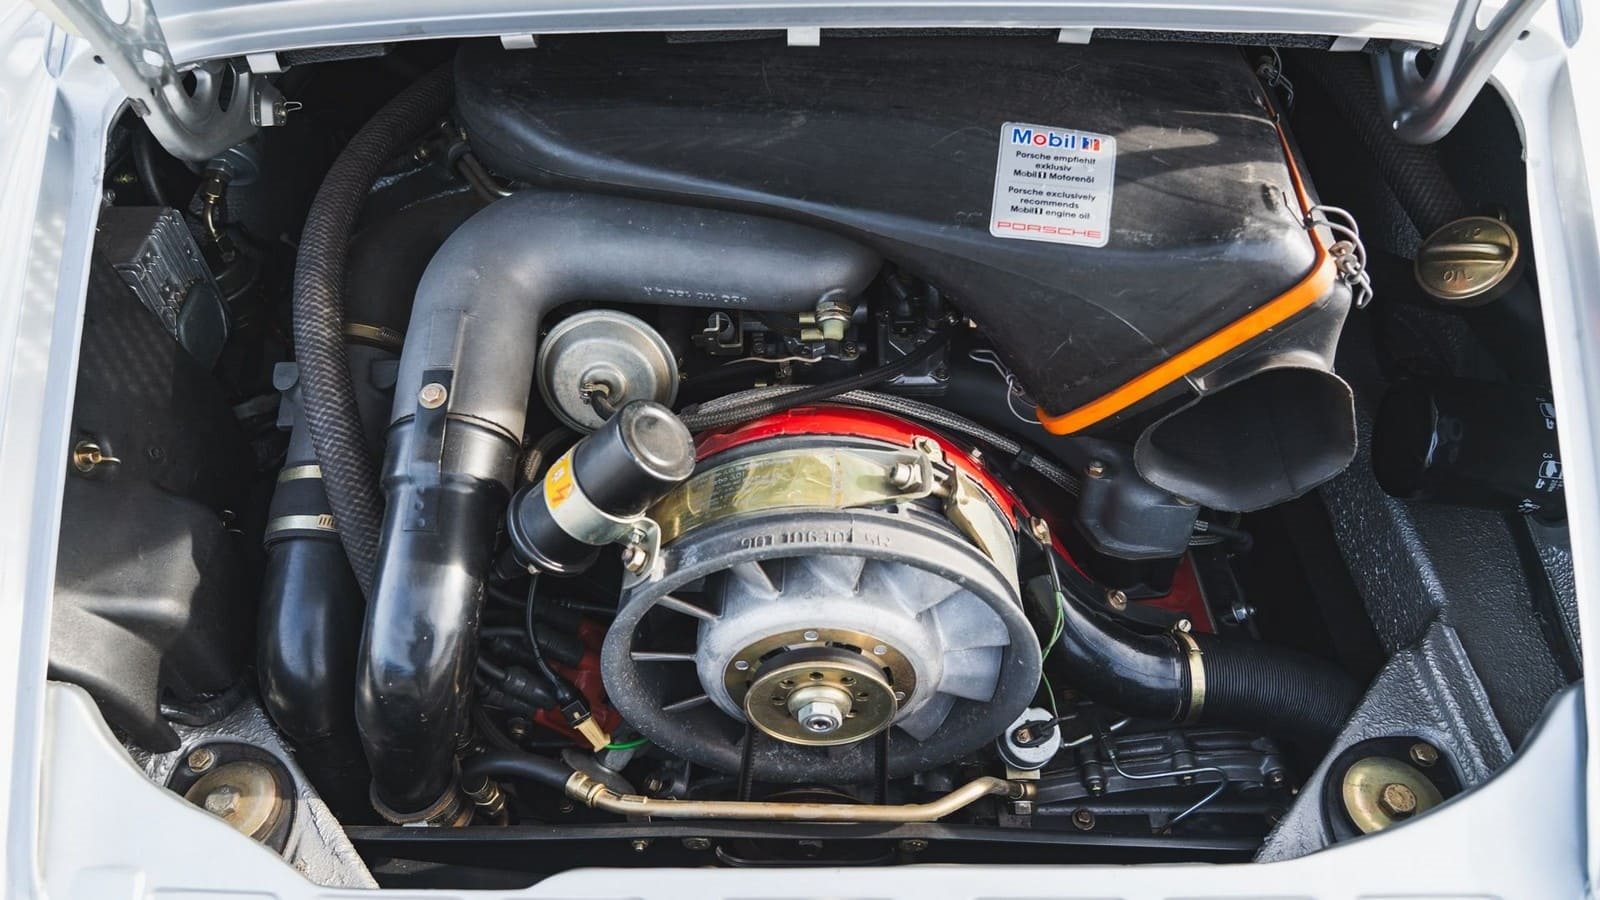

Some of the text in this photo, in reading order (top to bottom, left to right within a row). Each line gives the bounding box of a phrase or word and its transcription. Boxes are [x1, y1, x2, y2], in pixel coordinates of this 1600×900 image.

[1012, 128, 1075, 149] Mobil
[1016, 150, 1096, 165] Porsche empfiehlt
[1035, 162, 1072, 172] exklusiv
[1049, 172, 1095, 184] Motorenöl
[1008, 186, 1096, 202] Porsche exclusively
[1020, 197, 1079, 209] recommends
[1045, 210, 1077, 219] engine
[1078, 211, 1091, 220] oil
[997, 222, 1101, 238] PORSCHE
